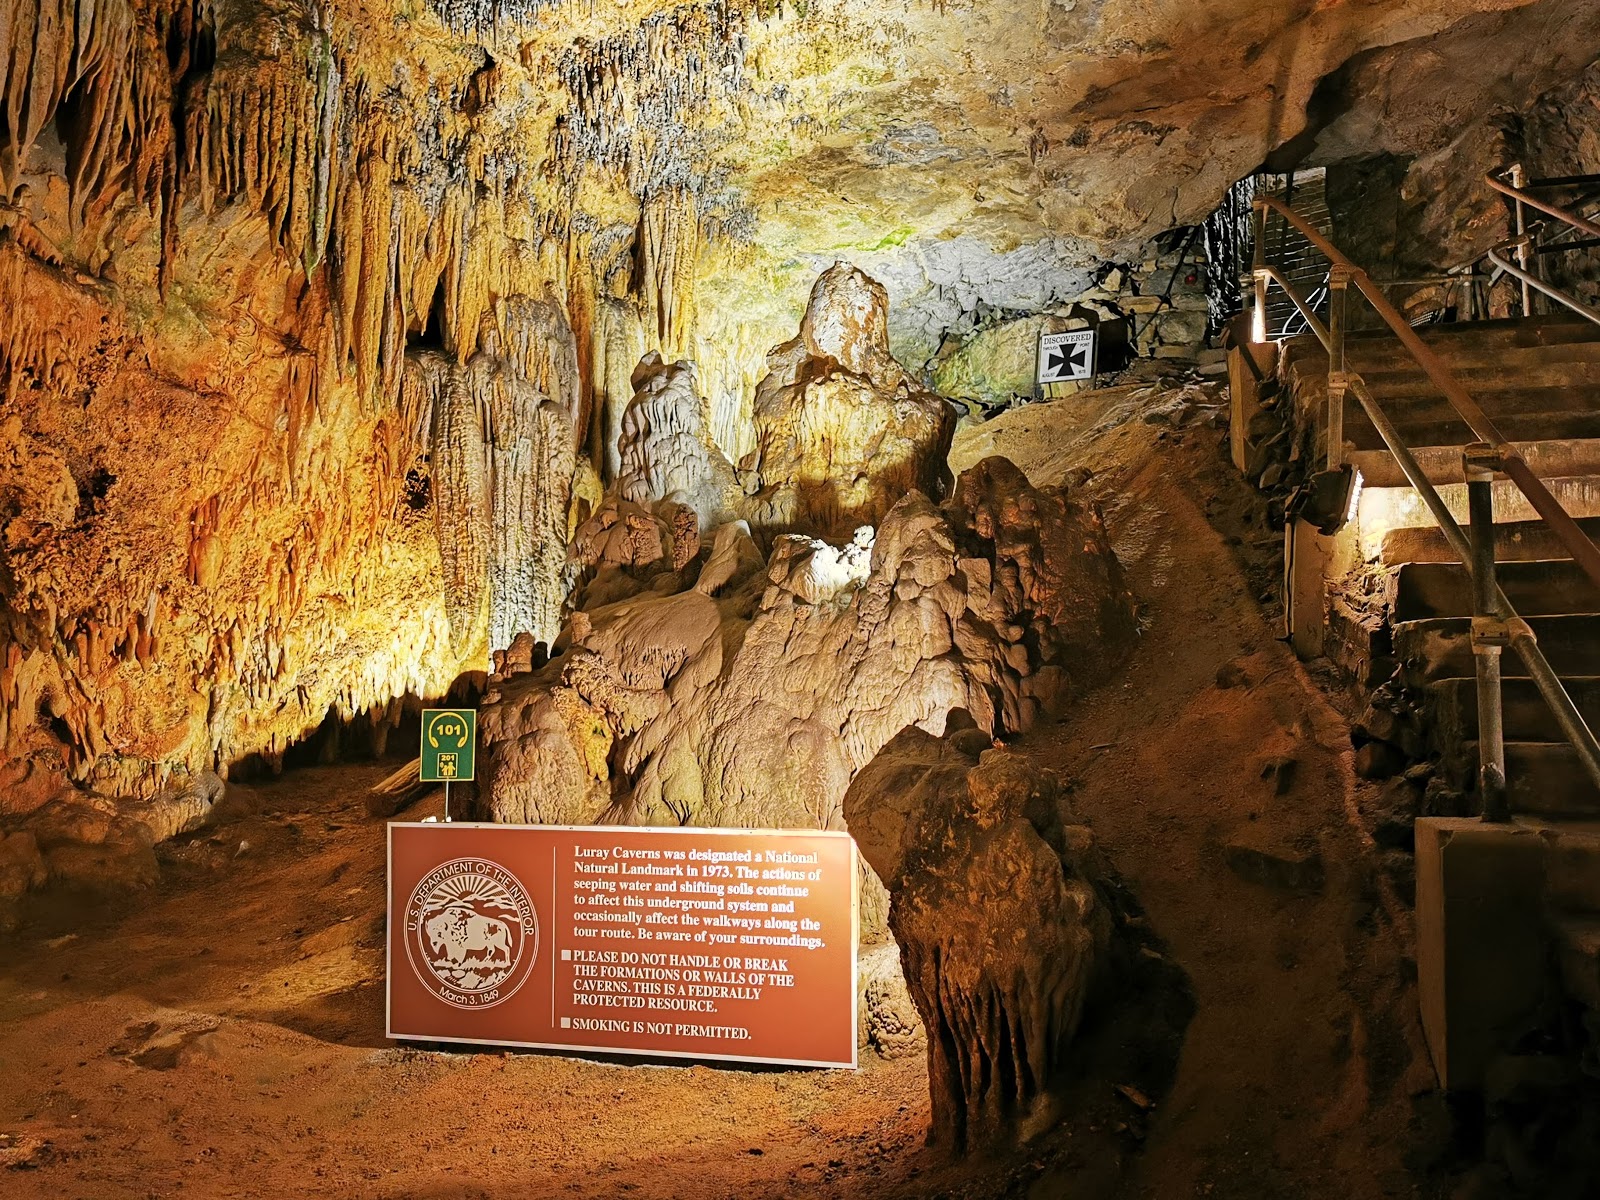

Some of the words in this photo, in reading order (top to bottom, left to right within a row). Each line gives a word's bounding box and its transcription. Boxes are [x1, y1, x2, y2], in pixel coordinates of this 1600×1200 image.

[1044, 334, 1091, 344] DISCOVERED
[437, 725, 461, 736] 101
[574, 846, 610, 860] Luray
[613, 846, 660, 859] Caverns
[664, 850, 686, 860] was
[688, 849, 752, 864] designated
[755, 852, 762, 863] a
[765, 850, 818, 864] National
[574, 862, 618, 874] Natural
[622, 863, 684, 876] Landmark
[686, 865, 698, 877] in
[702, 865, 733, 878] 1973.
[736, 866, 760, 879] The
[762, 868, 805, 880] actions
[808, 869, 822, 880] of
[574, 878, 616, 892] seeping
[619, 881, 652, 891] water
[655, 881, 677, 892] and
[680, 881, 725, 896] shifting
[727, 883, 754, 895] soils
[756, 884, 809, 897] continue
[415, 862, 473, 905] DEPARTMENT
[476, 863, 492, 875] OF
[494, 869, 512, 888] THE
[510, 884, 535, 936] INTERIOR
[574, 894, 586, 905] to
[588, 894, 620, 906] affect
[623, 895, 644, 907] this
[647, 897, 724, 911] underground
[727, 900, 768, 913] system
[771, 901, 794, 913] and
[574, 910, 642, 926] occasionally
[646, 912, 678, 924] affect
[681, 914, 700, 925] the
[703, 915, 761, 930] walkways
[764, 917, 798, 932] along
[801, 918, 820, 930] the
[574, 926, 598, 937] tour
[601, 928, 635, 939] route.
[638, 928, 653, 939] Be
[656, 931, 692, 941] aware
[694, 930, 708, 942] of
[709, 934, 737, 945] your
[740, 934, 826, 950] surroundings.
[573, 950, 619, 963] PLEASE
[621, 952, 639, 964] DO
[641, 953, 667, 965] NOT
[669, 954, 721, 968] HANDLE
[723, 957, 742, 970] OR
[744, 958, 789, 972] BREAK
[573, 965, 598, 977] THE
[600, 966, 680, 981] FORMATIONS
[682, 970, 701, 982] OR
[703, 971, 746, 984] WALLS
[748, 973, 766, 985] OF
[768, 974, 795, 987] THE
[439, 986, 468, 1004] March
[470, 995, 478, 1005] 3,
[480, 990, 499, 1003] 1849
[573, 979, 631, 993] CAVERNS.
[633, 982, 661, 994] THIS
[664, 984, 676, 995] IS
[677, 984, 686, 996] A
[688, 985, 762, 1000] FEDERALLY
[573, 993, 646, 1008] PROTECTED
[648, 997, 718, 1013] RESOURCE.
[572, 1018, 630, 1033] SMOKING
[633, 1022, 644, 1033] IS
[647, 1023, 673, 1035] NOT
[675, 1024, 752, 1040] PERMITTED.
